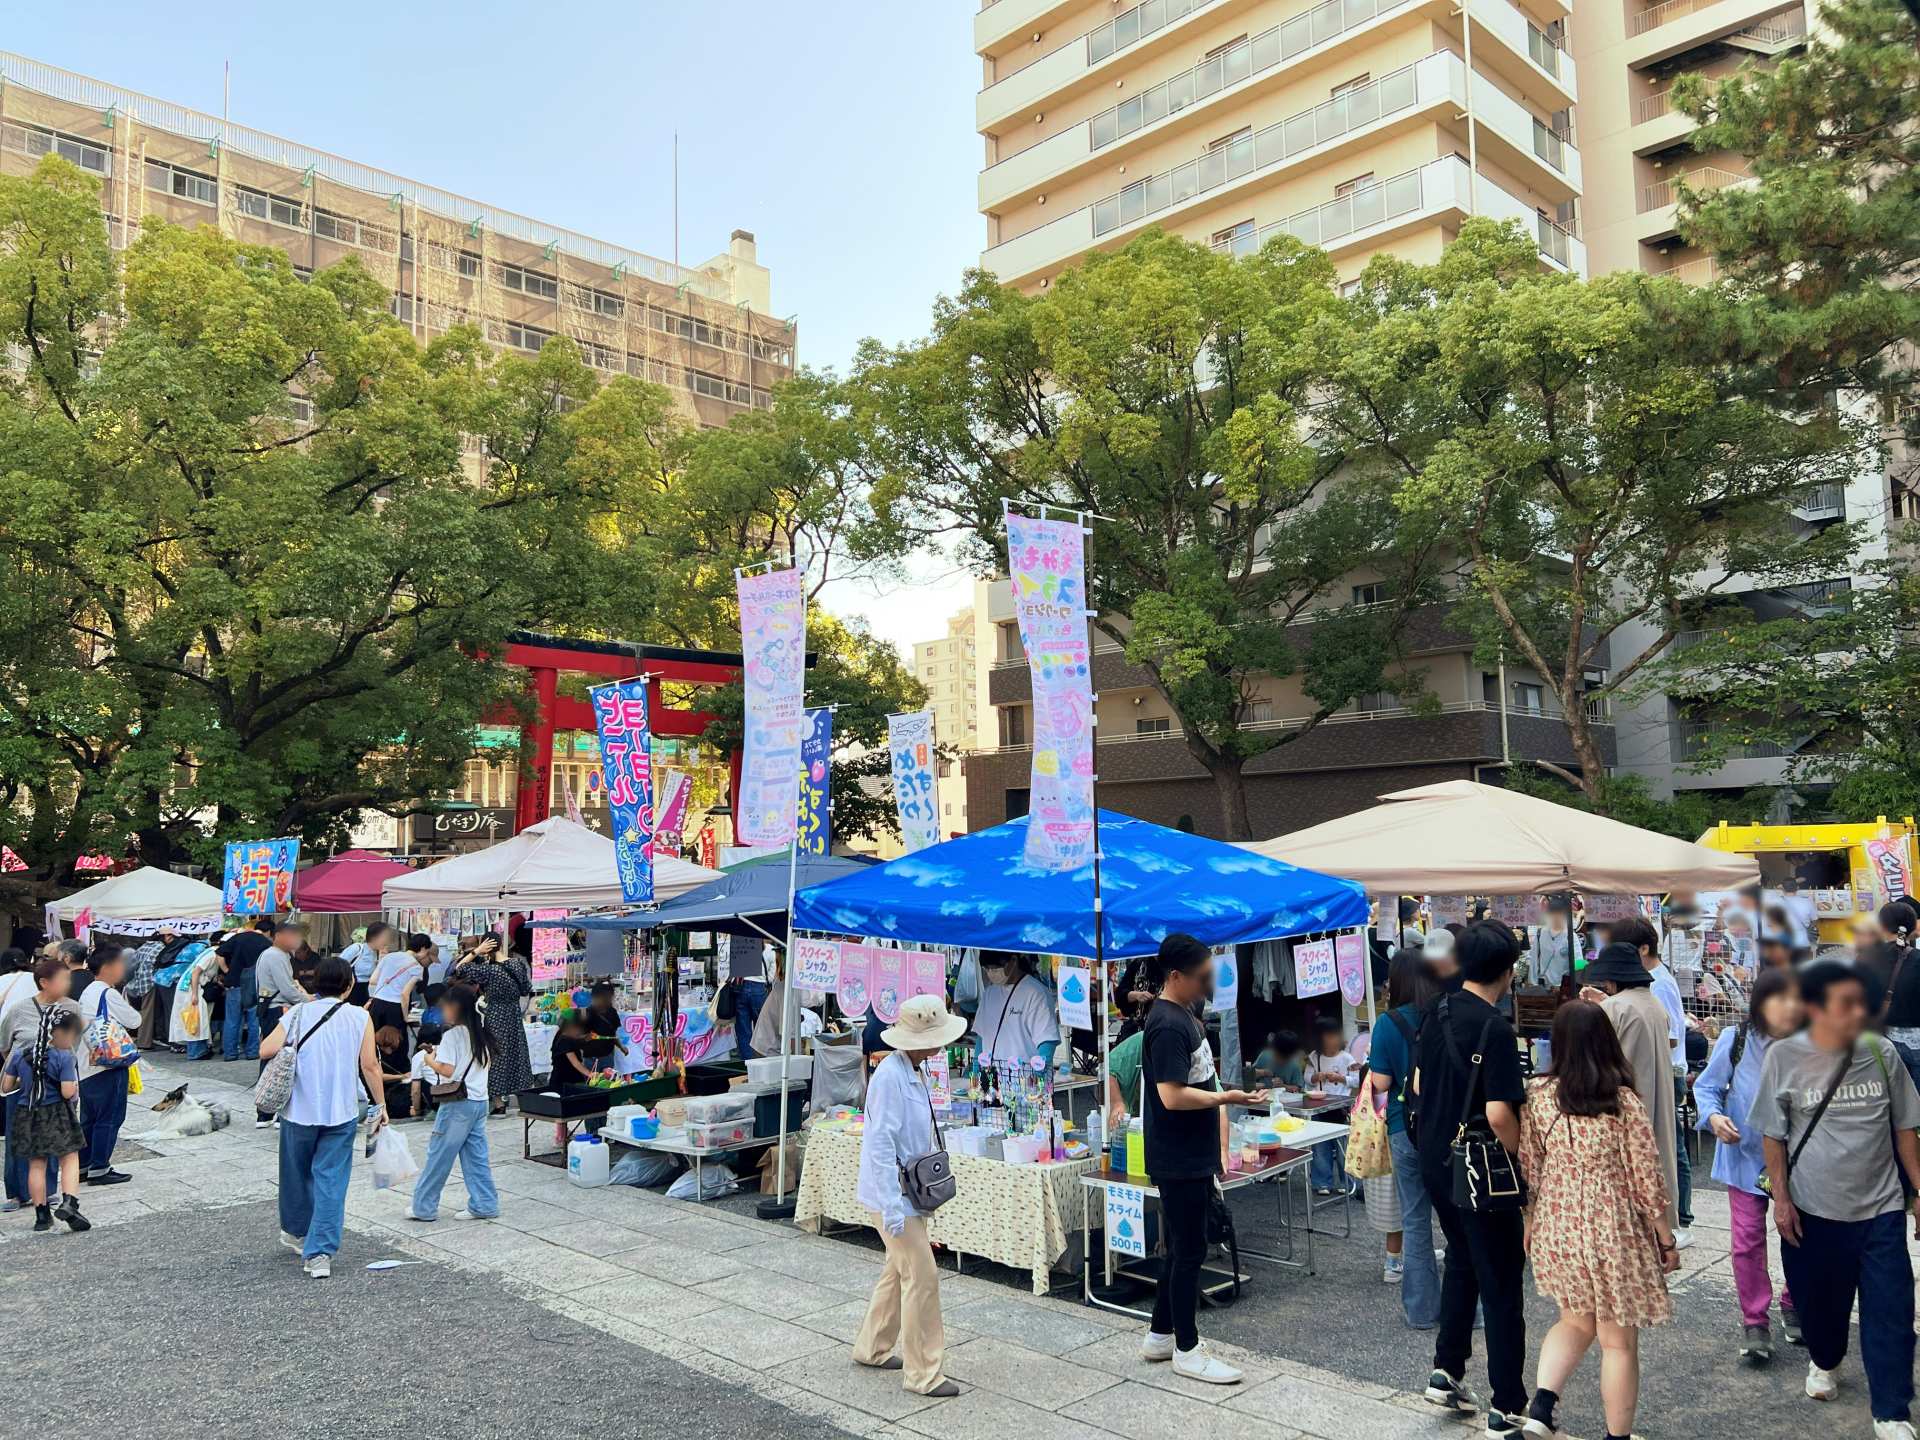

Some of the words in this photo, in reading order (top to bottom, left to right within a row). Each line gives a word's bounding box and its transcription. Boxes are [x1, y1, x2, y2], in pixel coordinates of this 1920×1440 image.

[1107, 1185, 1142, 1202] モミモミ
[1108, 1202, 1142, 1220] スライム
